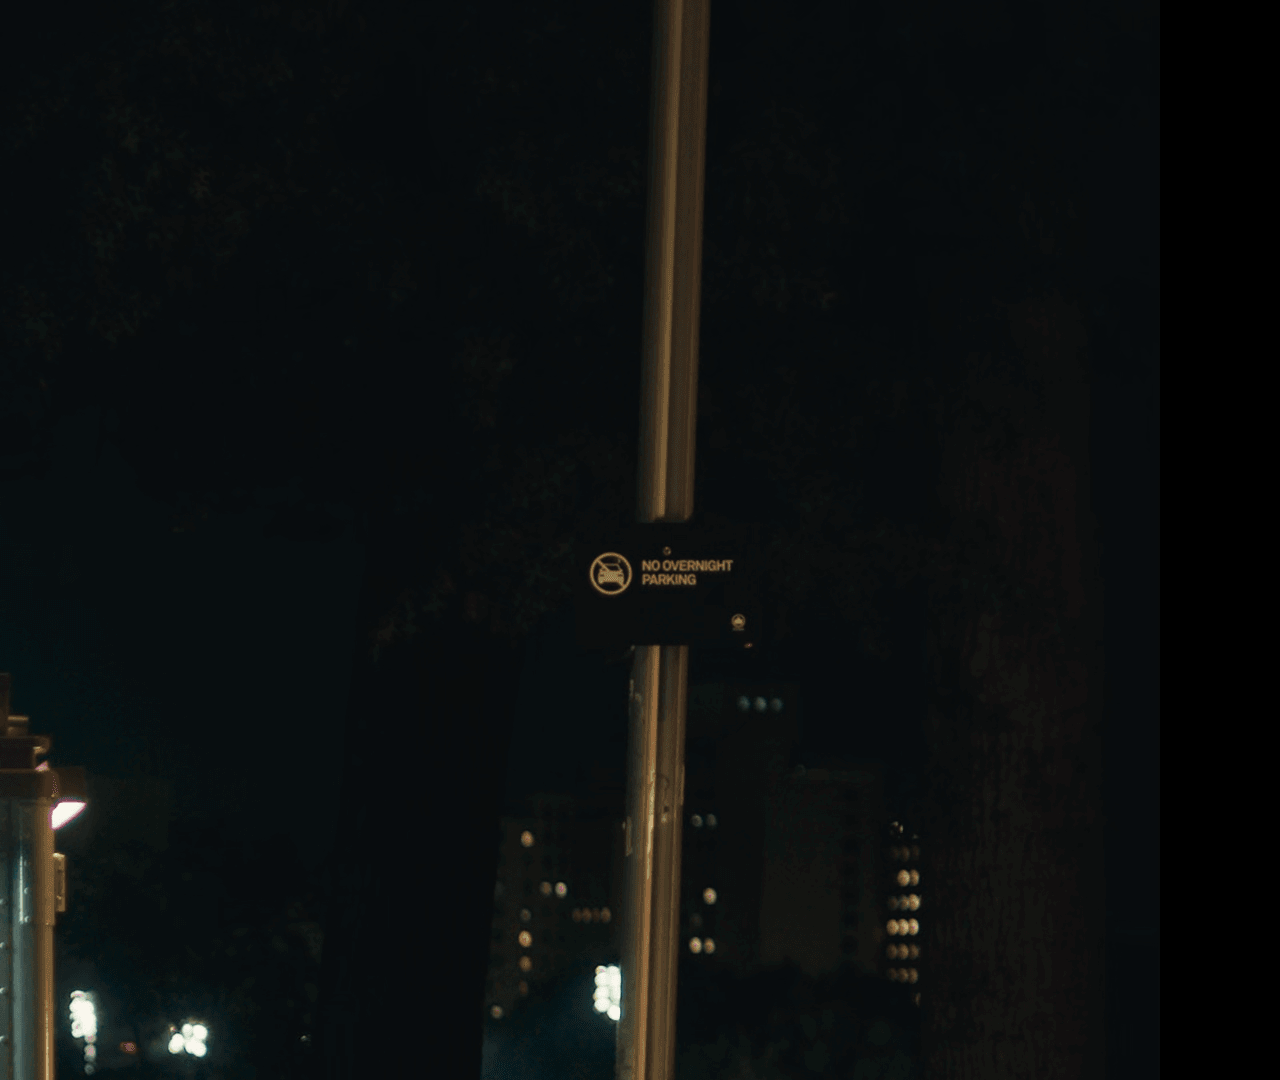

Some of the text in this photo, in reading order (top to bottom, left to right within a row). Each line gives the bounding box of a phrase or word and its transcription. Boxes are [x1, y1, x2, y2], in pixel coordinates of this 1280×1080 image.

[641, 558, 734, 573] NO OVERNIGHT
[641, 572, 698, 587] PARKING
